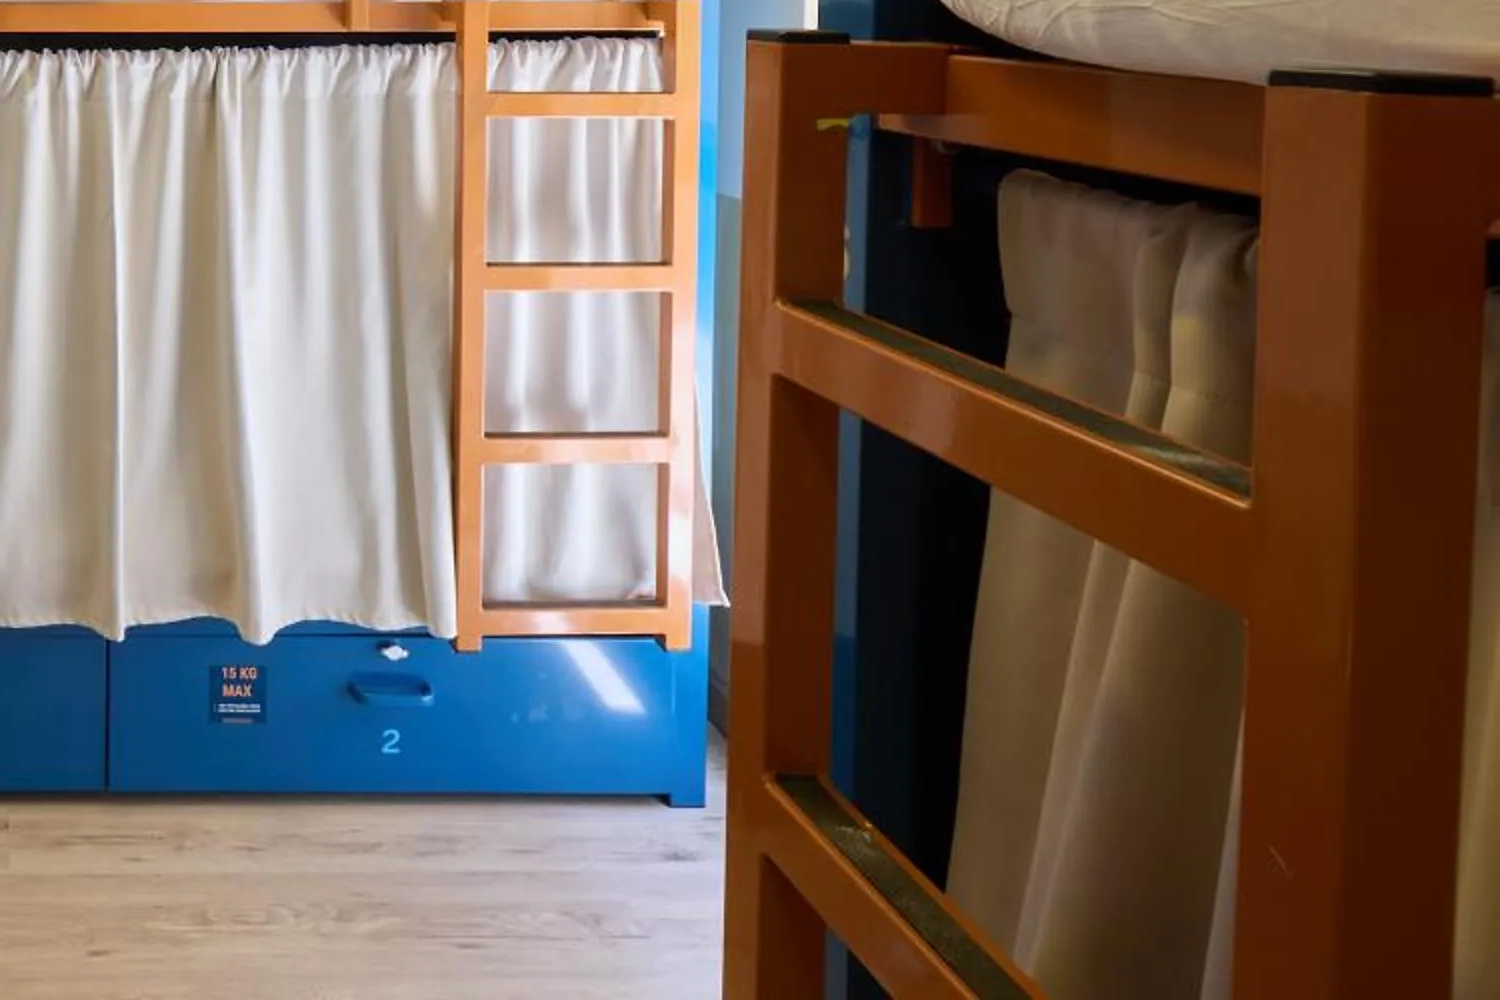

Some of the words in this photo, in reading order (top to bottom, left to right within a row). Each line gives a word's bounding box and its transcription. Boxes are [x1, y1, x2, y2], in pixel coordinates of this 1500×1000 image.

[221, 667, 237, 679] 15
[222, 683, 252, 697] MAX
[381, 729, 401, 754] 2
